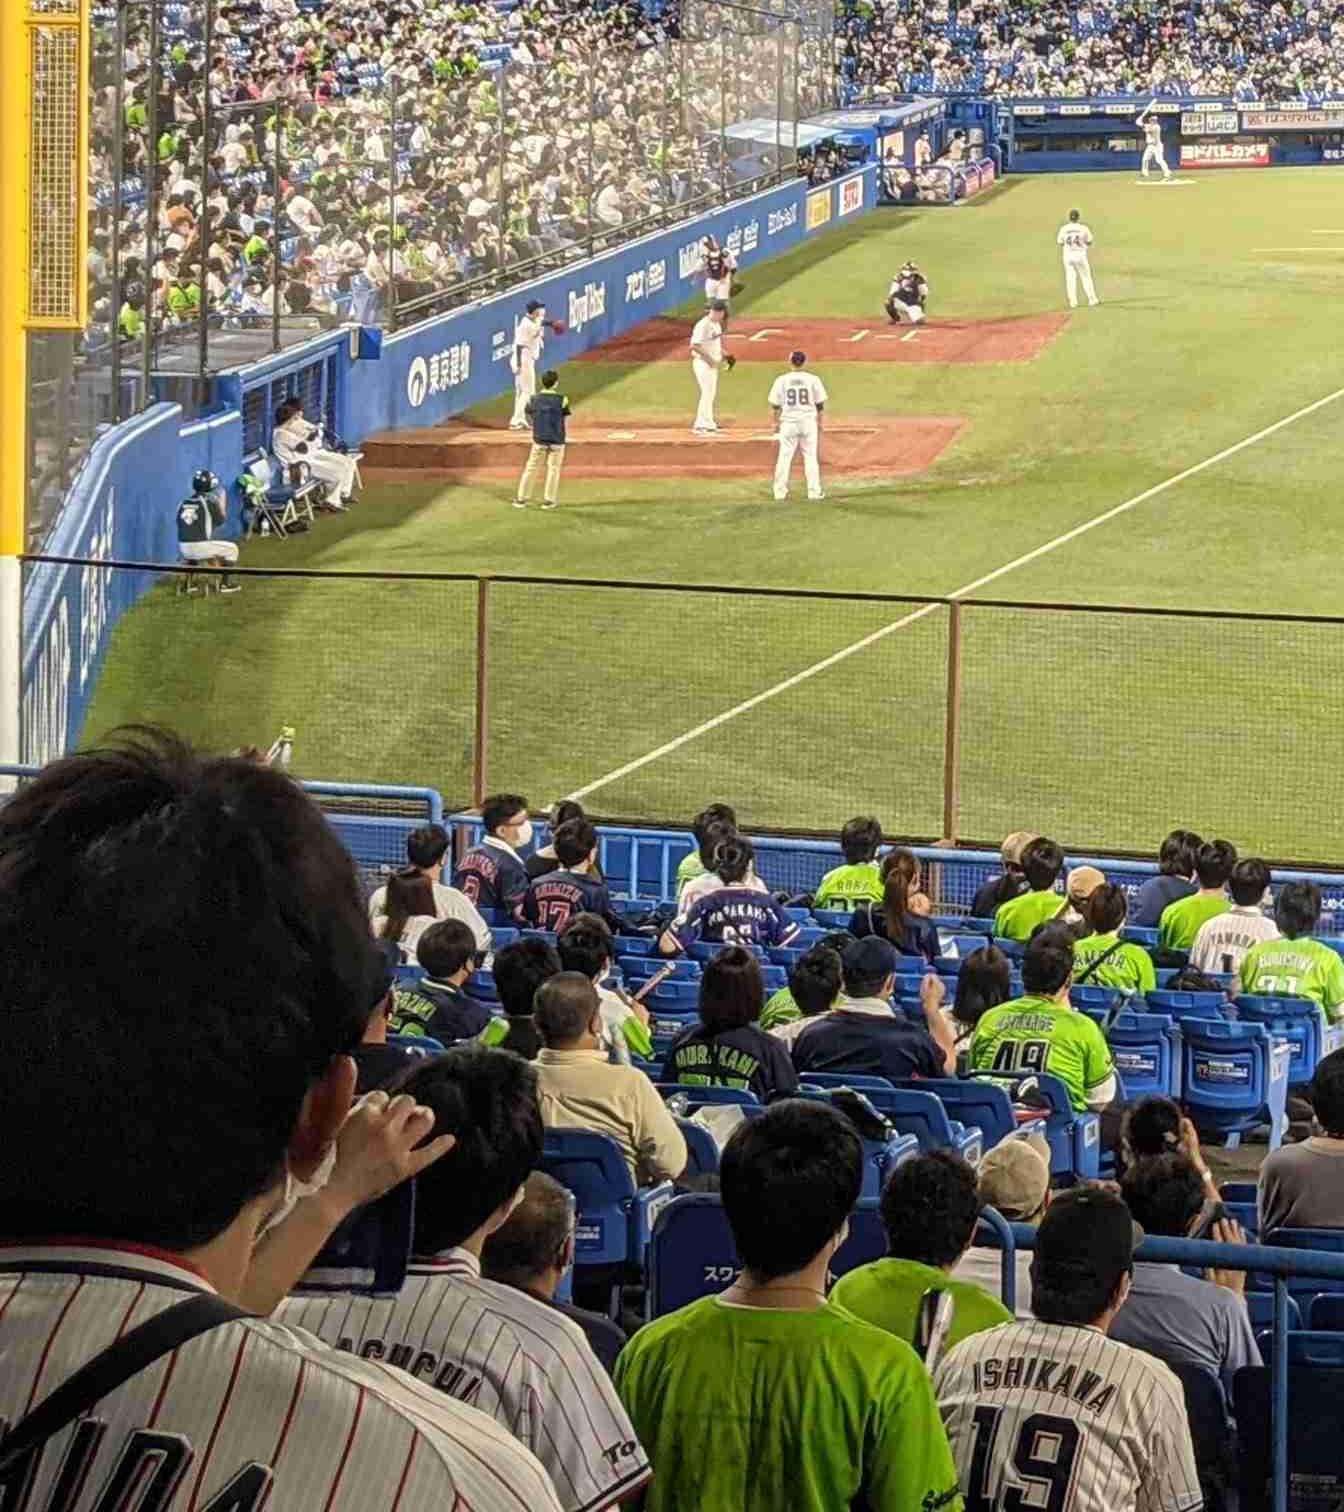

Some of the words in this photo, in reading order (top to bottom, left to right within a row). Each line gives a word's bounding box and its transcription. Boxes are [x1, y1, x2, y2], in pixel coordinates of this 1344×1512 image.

[787, 388, 809, 406] 98
[676, 1044, 760, 1078] MURKAMI
[973, 1356, 1118, 1418] ISHIKAWA
[967, 1402, 1089, 1512] 19
